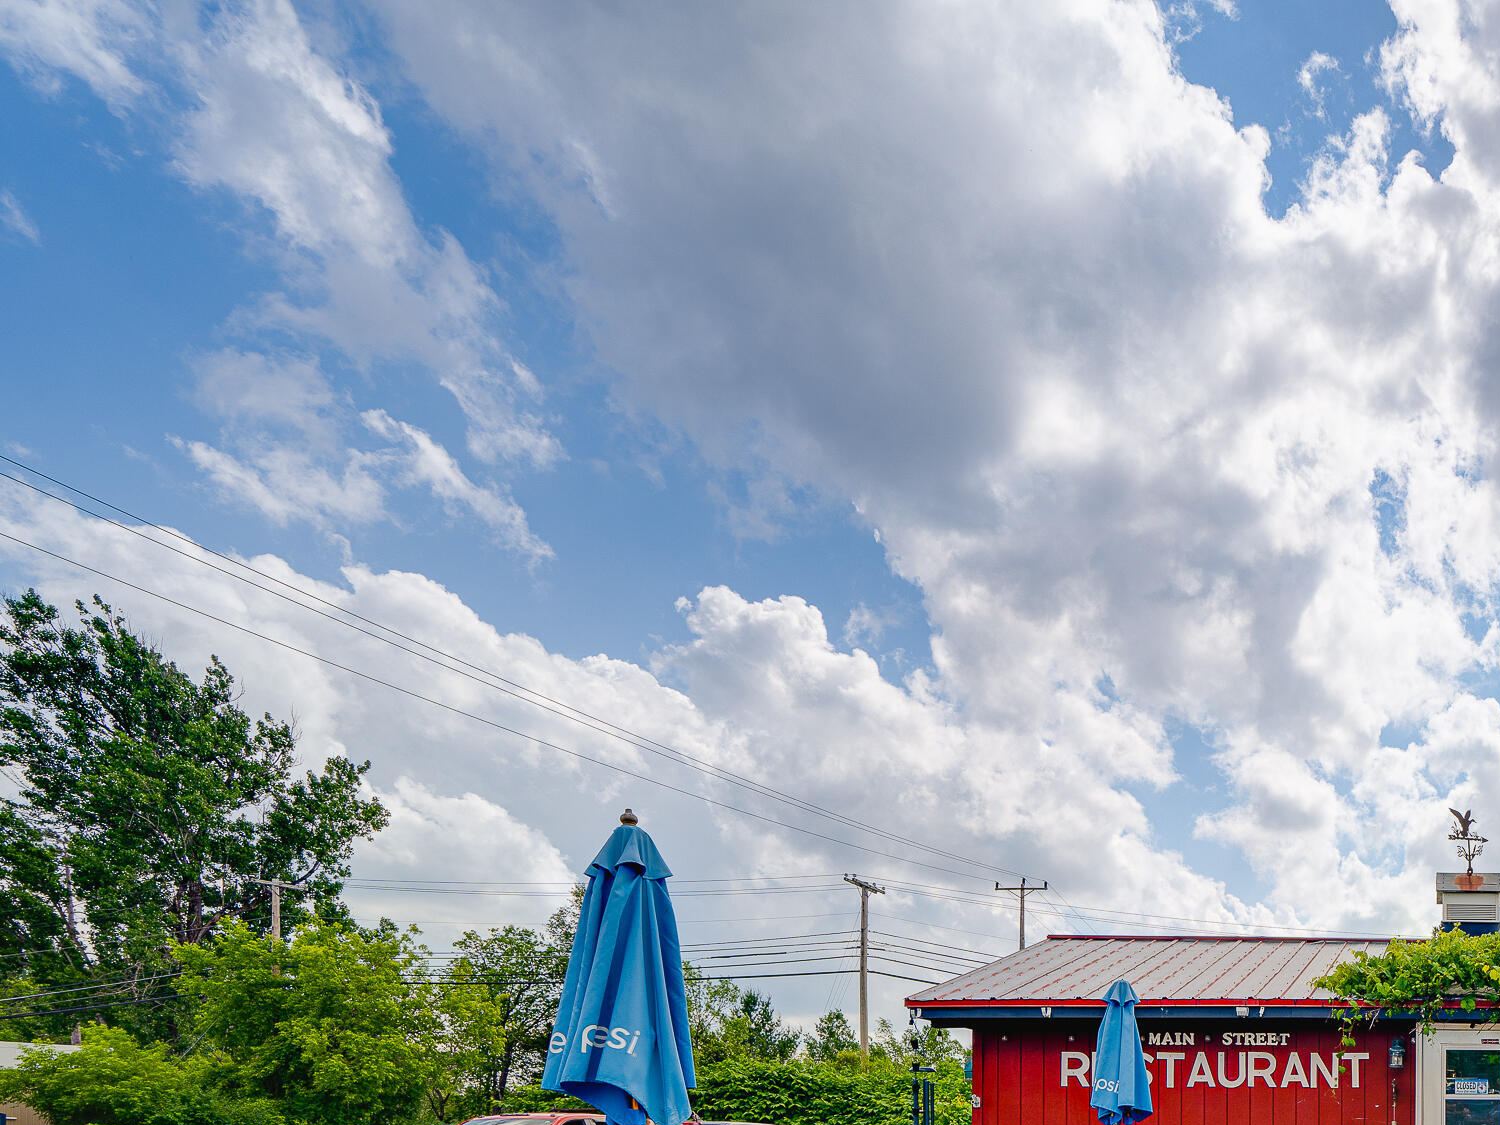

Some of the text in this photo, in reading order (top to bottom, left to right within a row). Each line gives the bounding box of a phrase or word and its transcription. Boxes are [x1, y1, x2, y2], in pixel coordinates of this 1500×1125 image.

[1149, 1032, 1290, 1046] MAIN STREET
[1060, 1051, 1370, 1088] RTAURANT
[1094, 1078, 1120, 1094] psi
[1456, 1081, 1477, 1090] CLOSED
